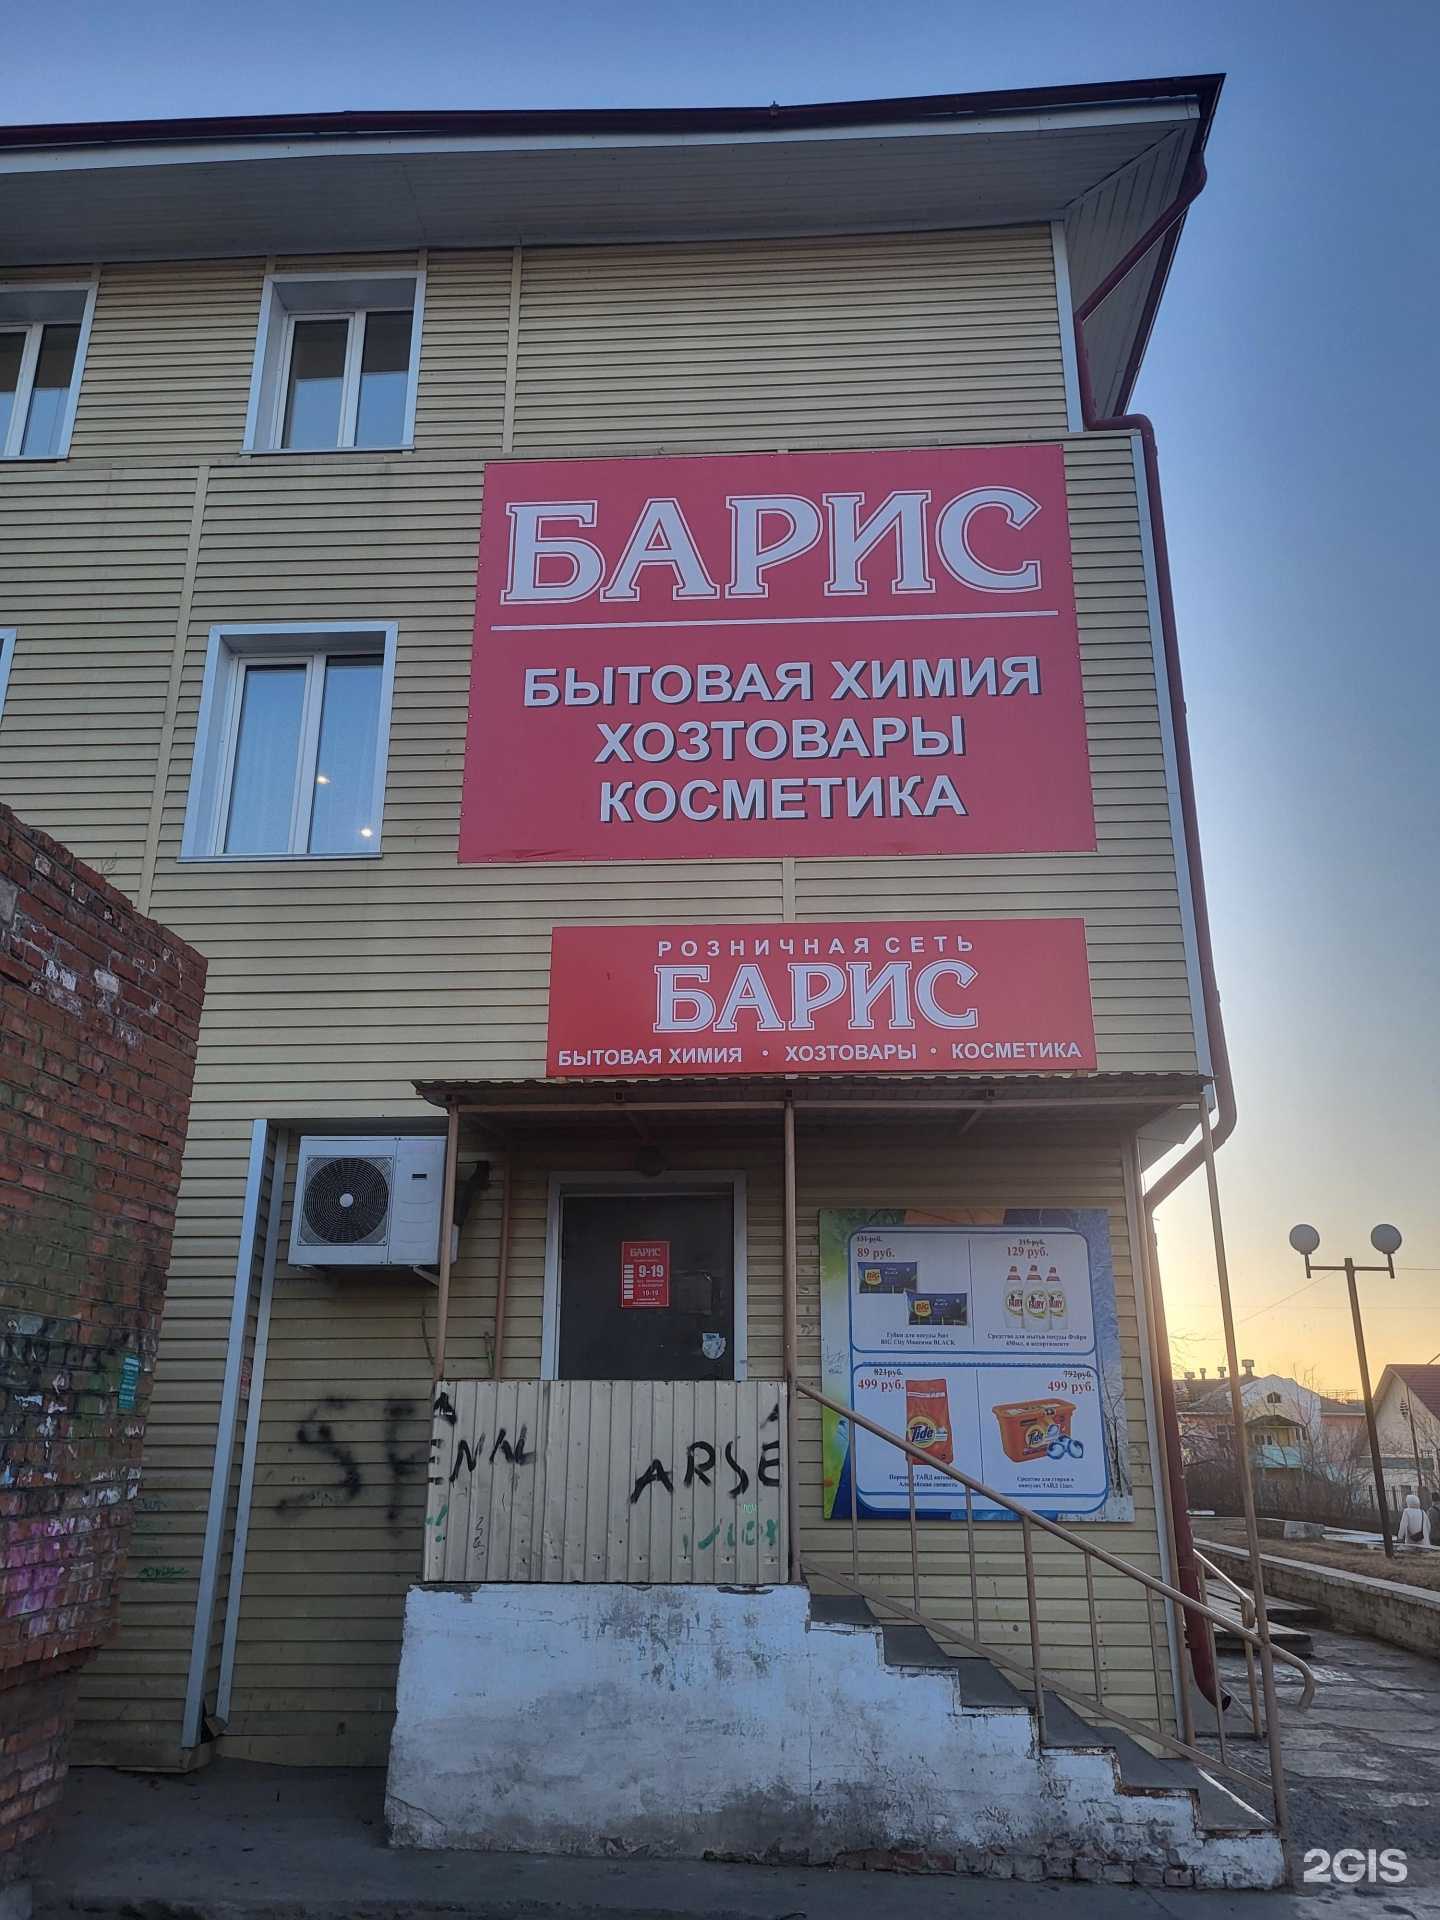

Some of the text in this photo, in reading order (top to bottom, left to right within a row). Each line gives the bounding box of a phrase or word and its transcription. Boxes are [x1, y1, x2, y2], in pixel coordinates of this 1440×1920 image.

[500, 485, 1042, 605] БАРИС
[523, 655, 1041, 707] БЫТОВАЯ ХИМИЯ
[594, 715, 966, 764] ХОЗТОВАРЫ
[599, 775, 967, 823] КОСМЕТИКА
[657, 935, 973, 957] РОЗНИЧНАЯ СЕТЬ
[653, 959, 979, 1033] БАРИС
[558, 1042, 1083, 1066] БЫТОВАЯ ХИМИЯ ХОЗТОВАРЫ КОСМЕТИКА
[630, 1247, 661, 1257] БАРИС
[857, 1247, 896, 1260] 89 руб.
[1007, 1246, 1049, 1259] 129 руб.
[639, 1264, 664, 1278] 9-19
[1029, 1300, 1045, 1309] FAIRY
[858, 1379, 905, 1392] 499 руб.
[1048, 1381, 1095, 1394] 499 руб.
[910, 1425, 934, 1442] Tide
